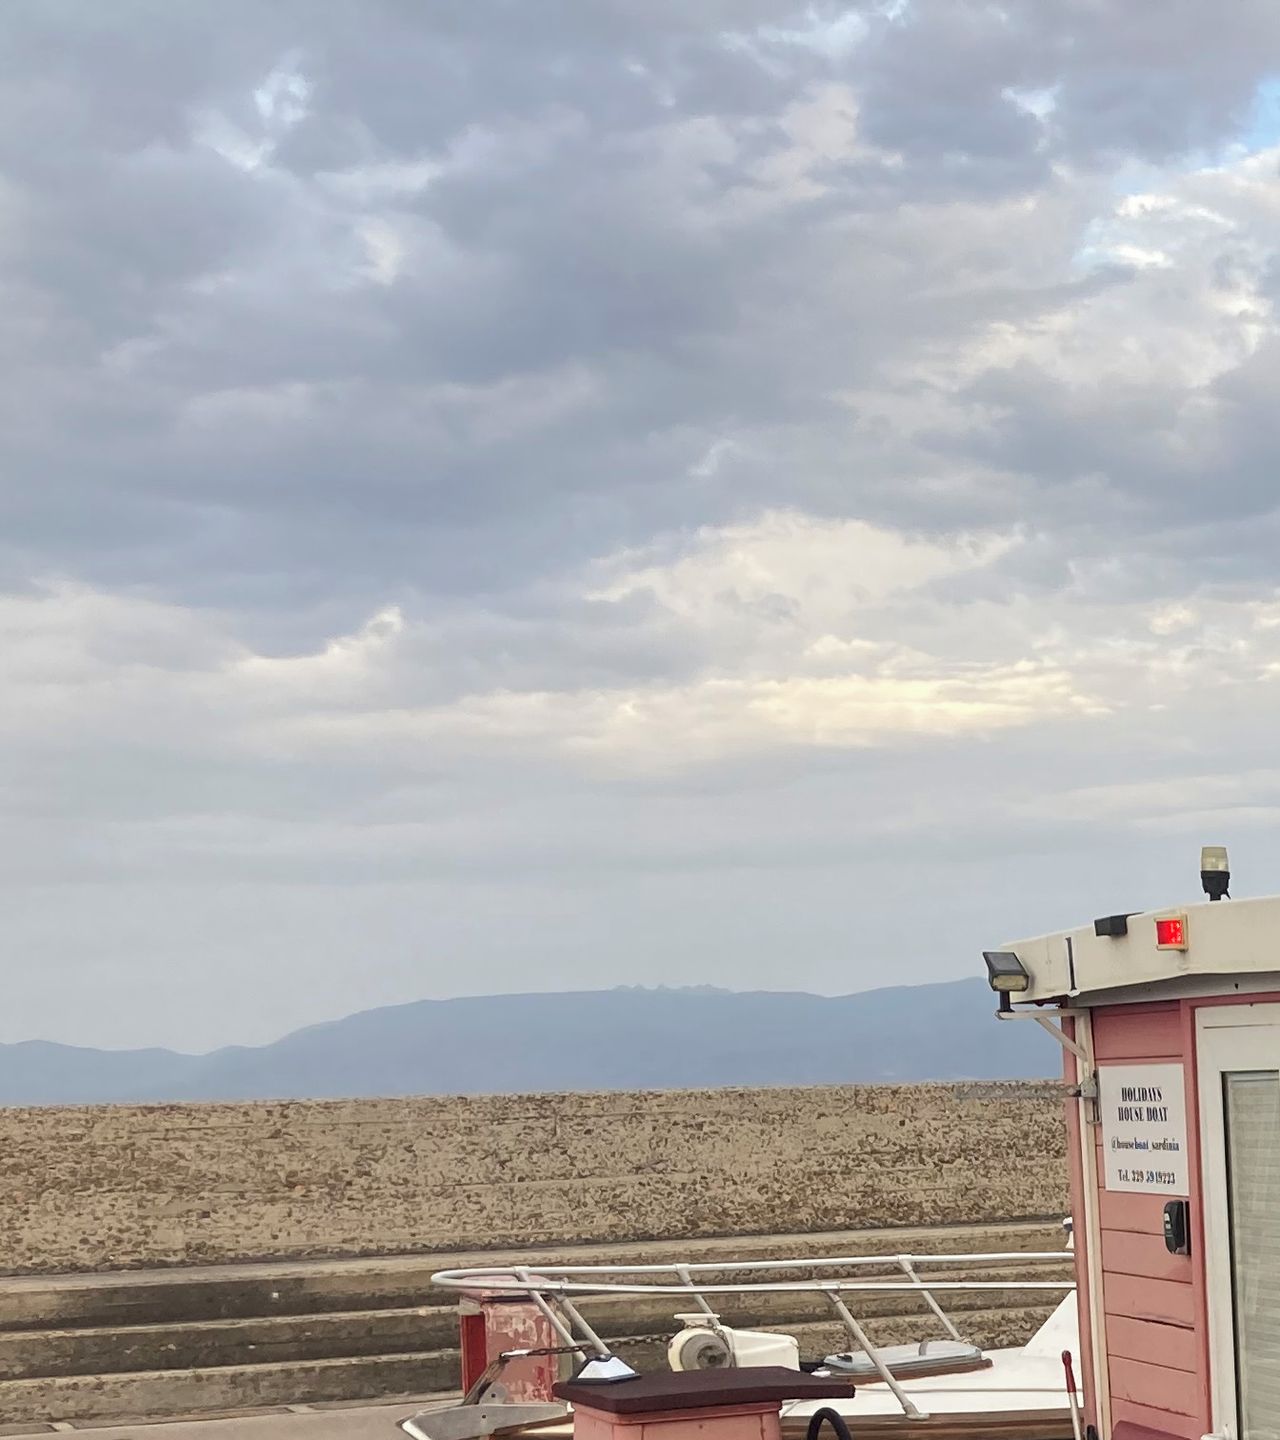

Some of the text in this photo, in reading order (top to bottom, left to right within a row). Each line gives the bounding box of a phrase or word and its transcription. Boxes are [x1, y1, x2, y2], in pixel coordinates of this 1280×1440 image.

[1120, 1087, 1163, 1102] HOLIDAYS
[1117, 1106, 1169, 1122] HOUSE BOAT
